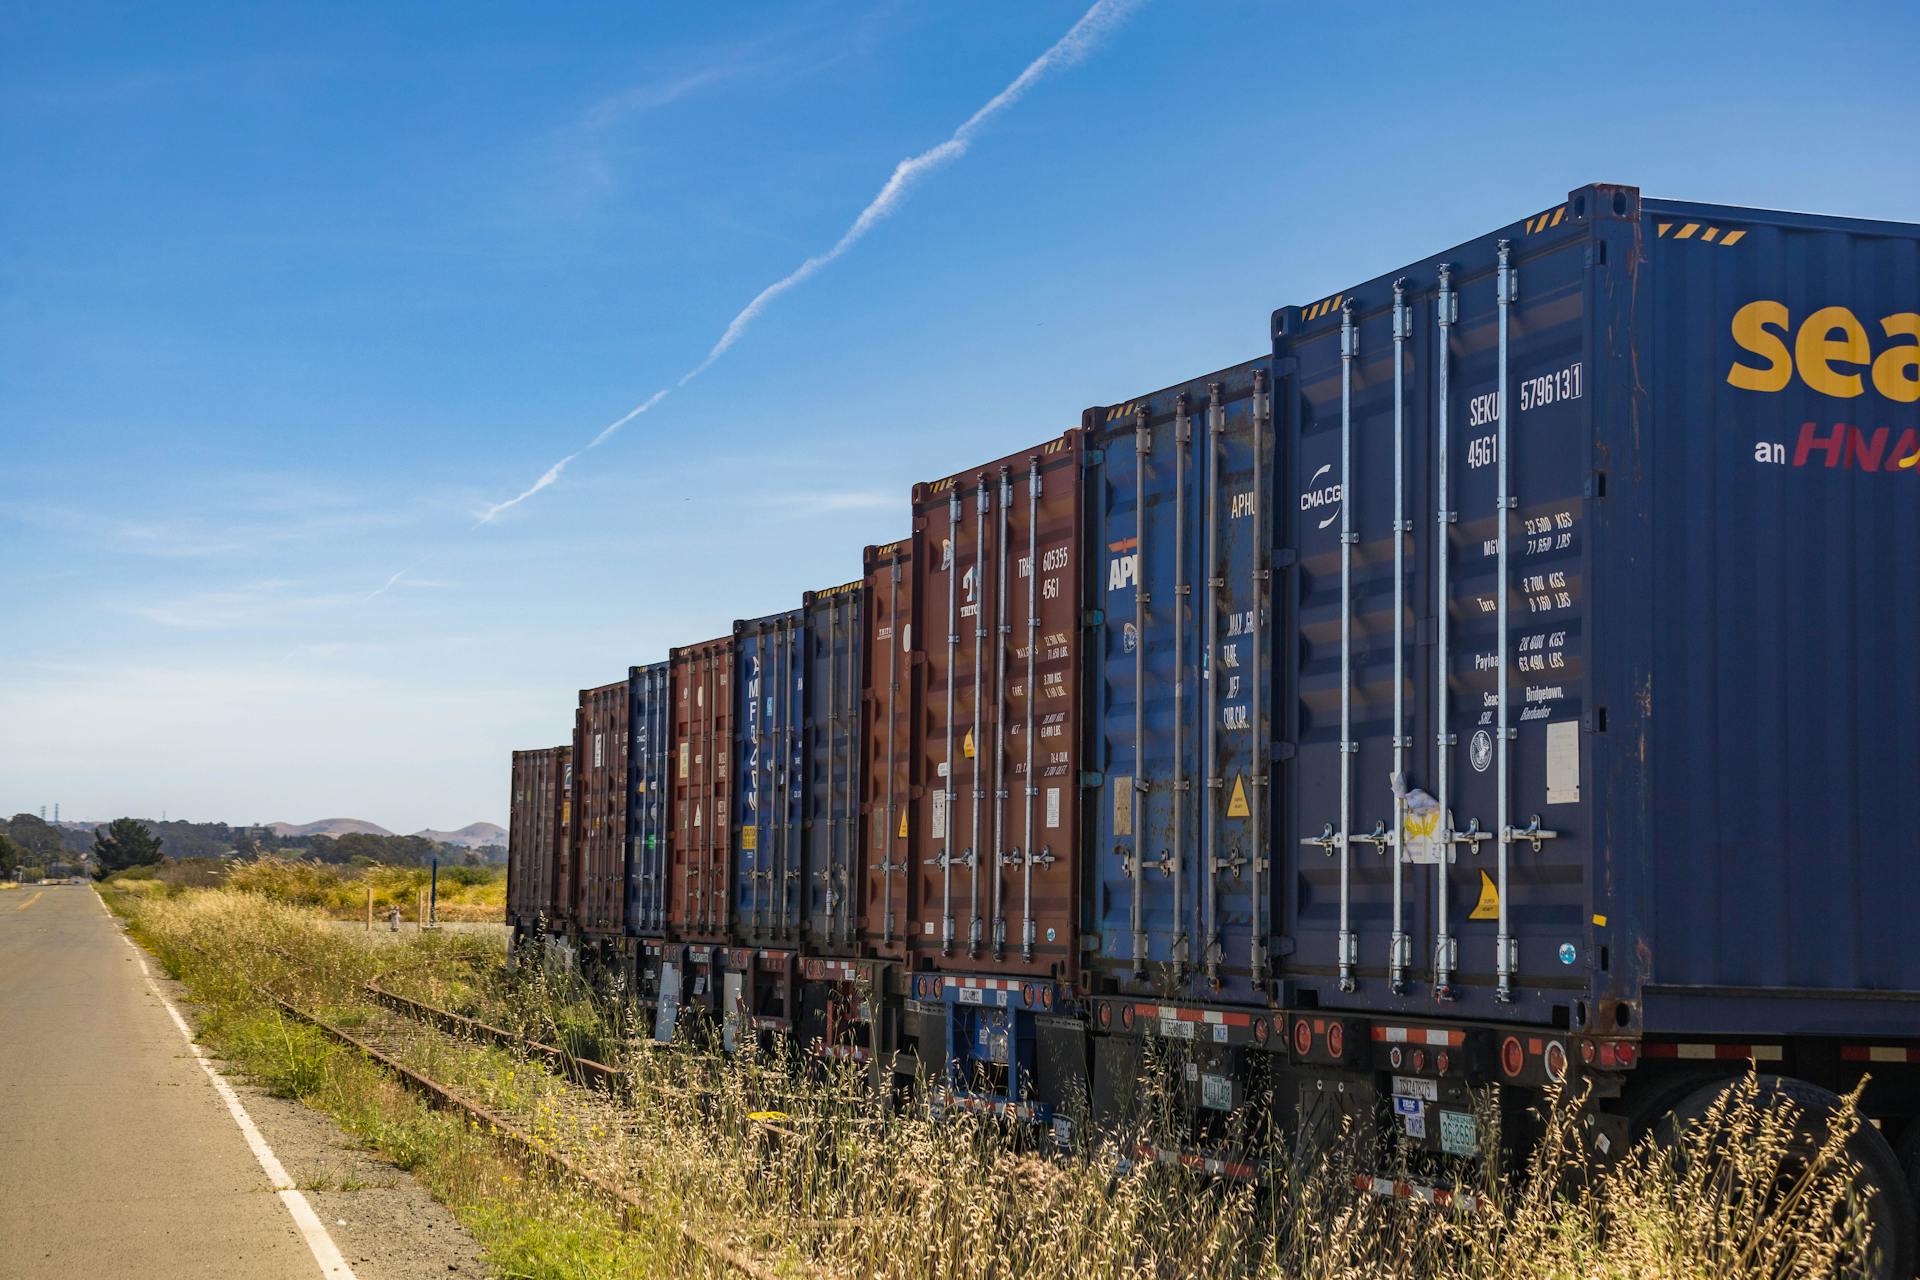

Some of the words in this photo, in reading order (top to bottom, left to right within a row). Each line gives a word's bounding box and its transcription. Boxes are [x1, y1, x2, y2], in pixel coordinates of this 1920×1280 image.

[1726, 300, 1920, 403] sea
[1470, 391, 1499, 427] SEKU
[1520, 362, 1582, 411] 5796131
[1467, 433, 1497, 469] 45G1
[1754, 441, 1785, 465] an
[1324, 483, 1344, 504] CG
[1555, 511, 1573, 530] KGS
[1555, 532, 1572, 550] LBS
[1549, 571, 1566, 589] KGS
[1476, 597, 1497, 613] Tare
[1555, 592, 1572, 609] LBS
[1548, 631, 1566, 648] KGS
[1548, 651, 1565, 669] LBS
[1525, 684, 1564, 704] Bridgetown,
[1520, 705, 1552, 721] Barbados
